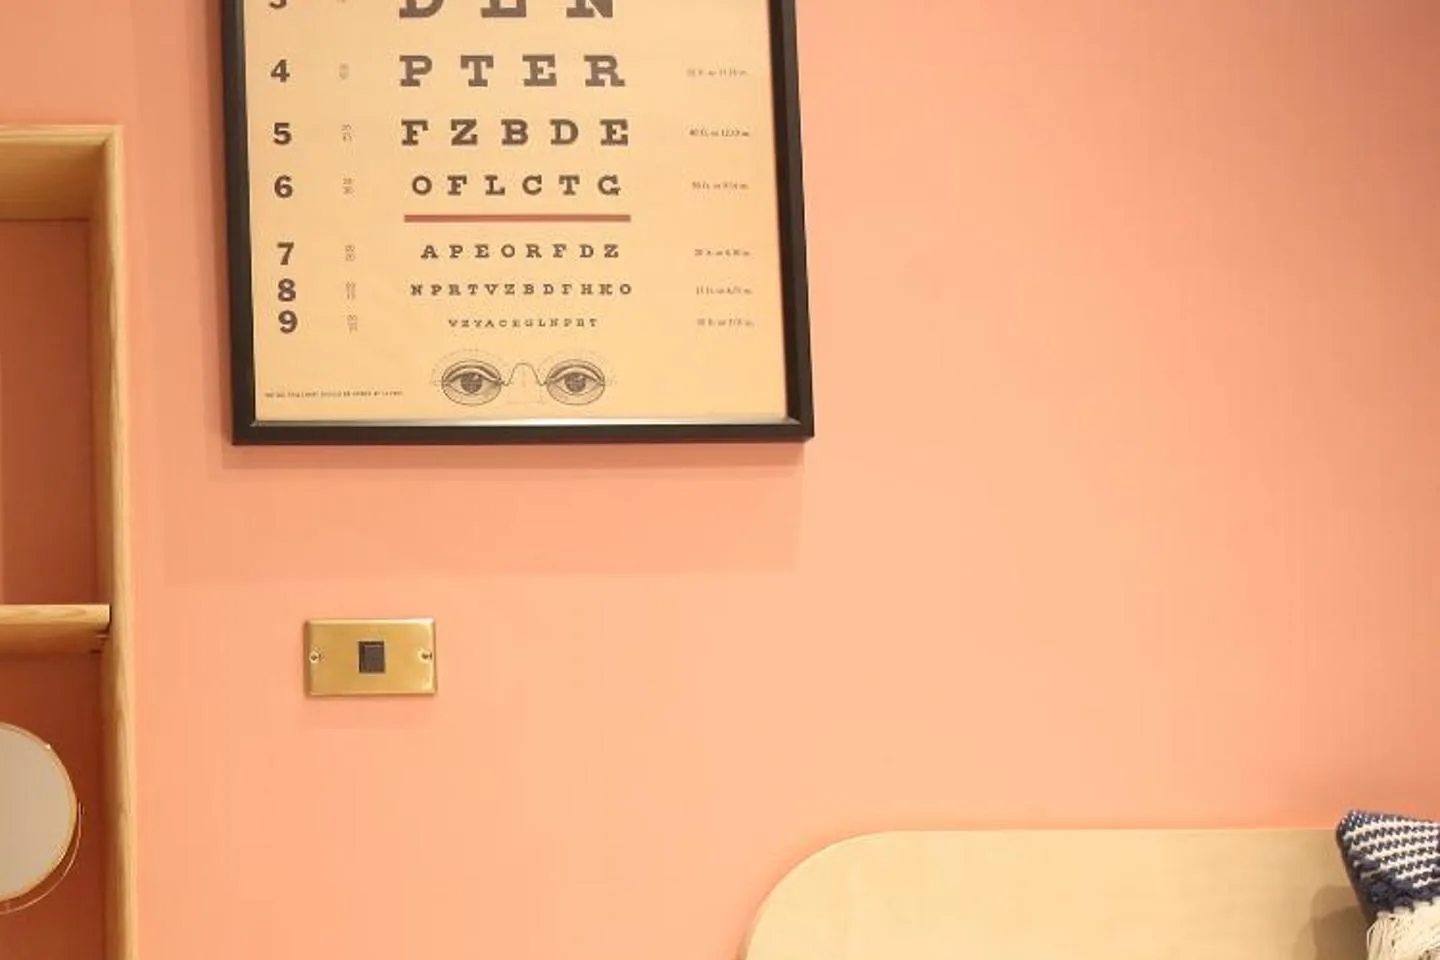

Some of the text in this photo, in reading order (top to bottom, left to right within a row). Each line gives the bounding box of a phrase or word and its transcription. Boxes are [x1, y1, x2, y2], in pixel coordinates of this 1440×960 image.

[270, 59, 291, 83] 4
[399, 53, 626, 88] PTER
[273, 122, 292, 146] 5
[401, 118, 629, 146] FZBDE
[274, 174, 293, 199] 6
[411, 174, 621, 196] OFLCTG
[277, 241, 295, 266] 7
[420, 243, 619, 260] APEORFDZ
[277, 278, 297, 302] 8
[410, 283, 632, 296] NPRTVZBDFHKO
[278, 309, 298, 335] 9
